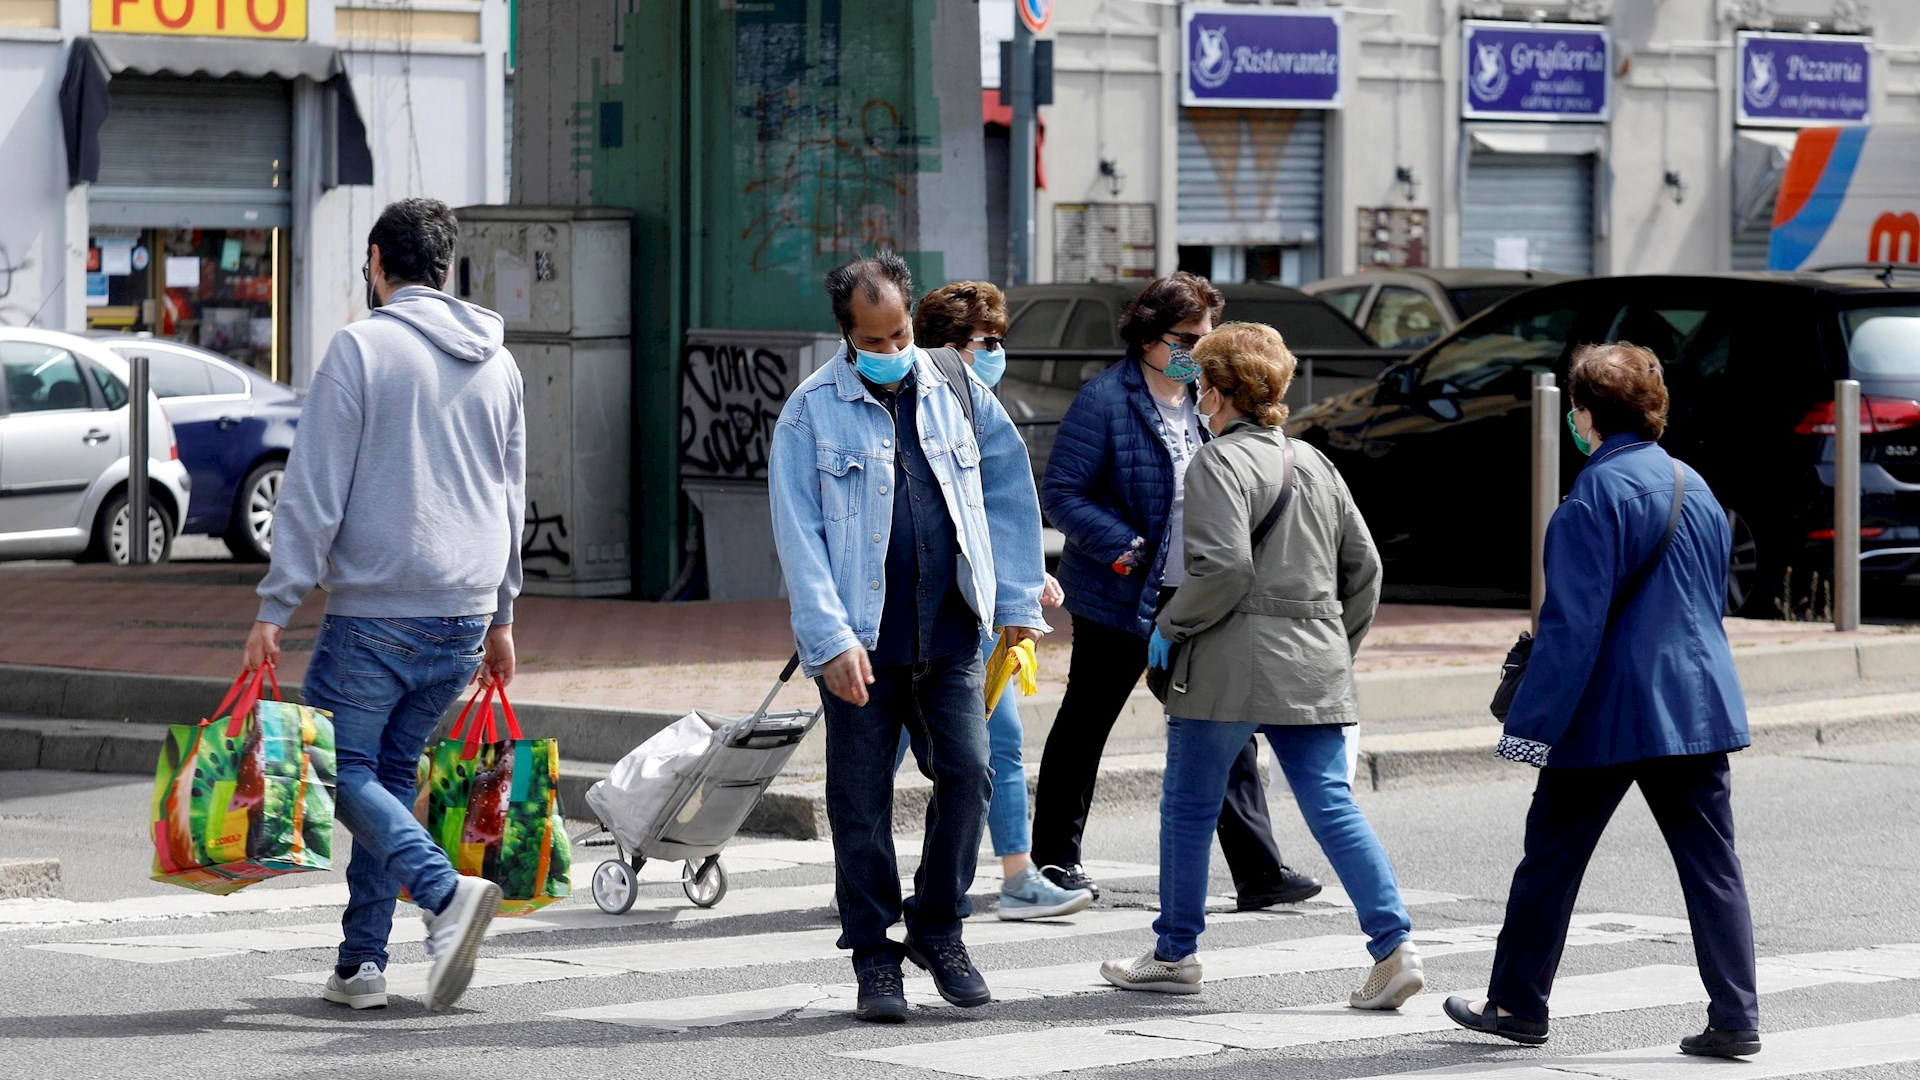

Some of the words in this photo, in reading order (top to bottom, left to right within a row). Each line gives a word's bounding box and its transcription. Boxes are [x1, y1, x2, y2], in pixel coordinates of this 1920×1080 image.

[1233, 46, 1337, 74] Ristorante
[1786, 54, 1863, 82] Pizzeria
[1885, 445, 1918, 456] GOLF
